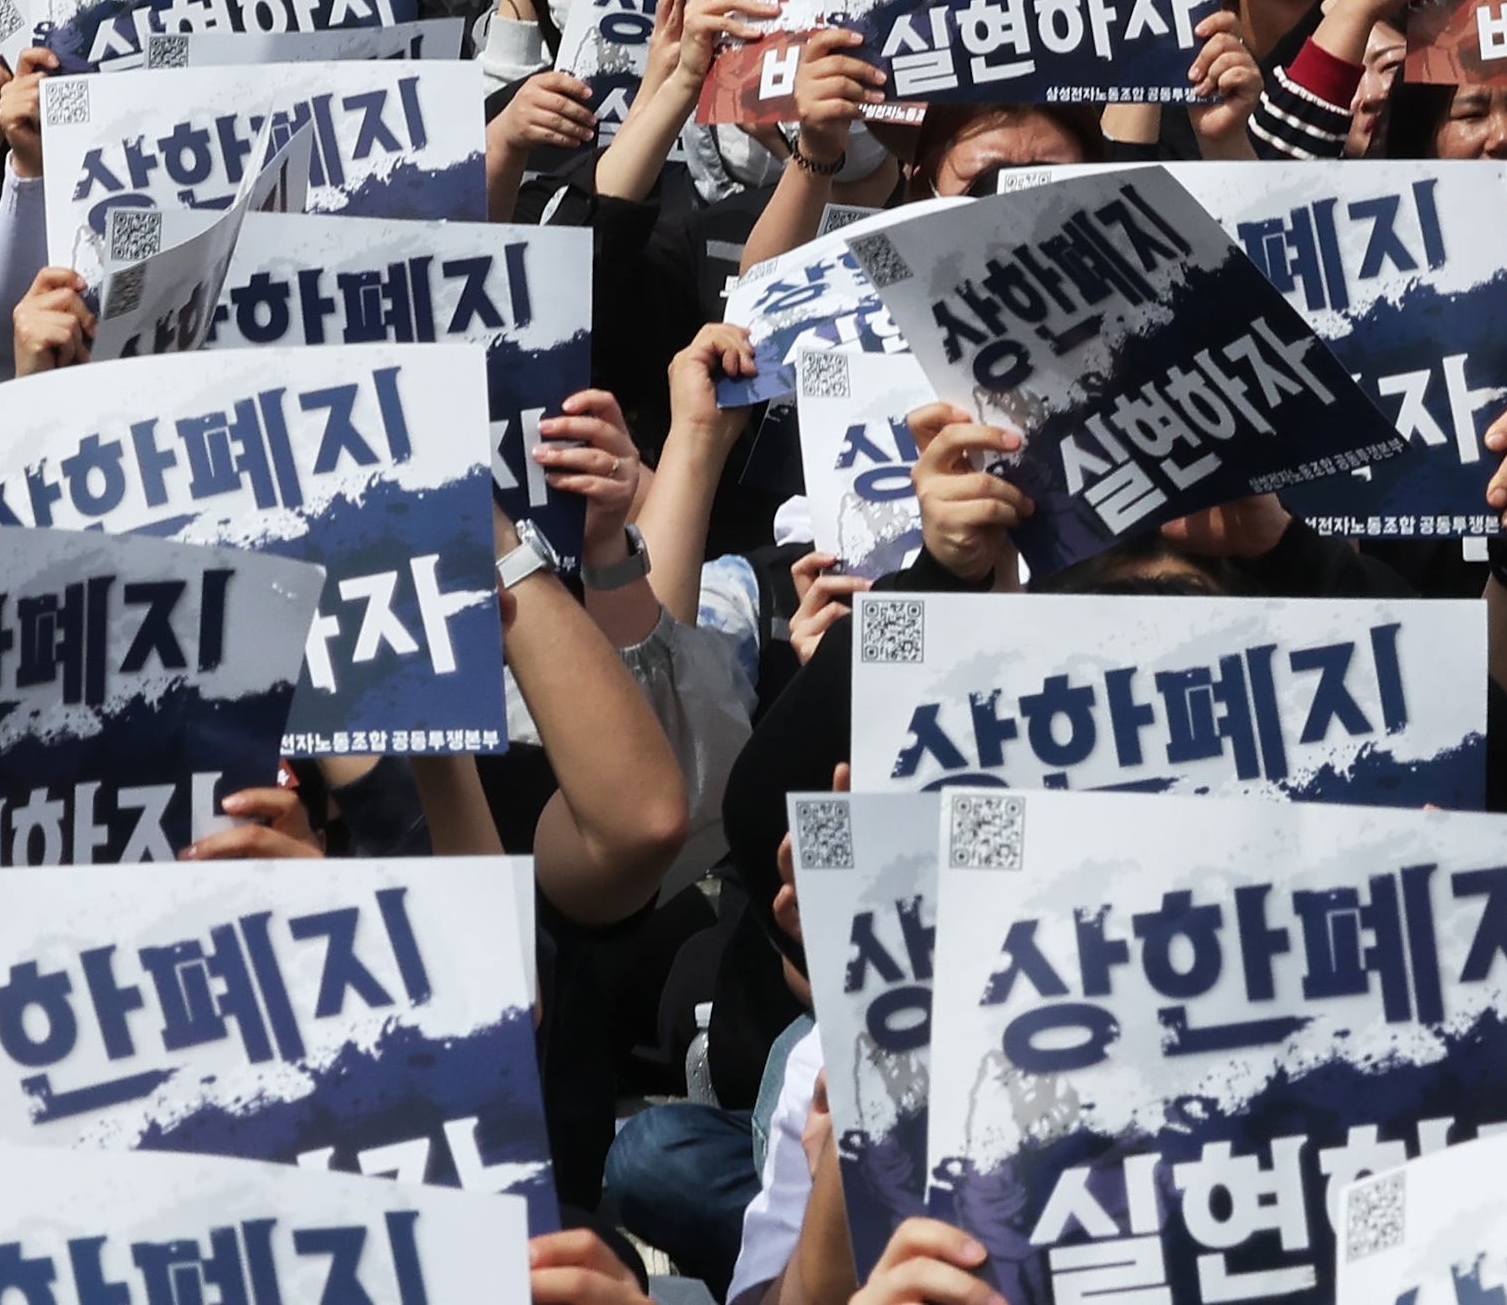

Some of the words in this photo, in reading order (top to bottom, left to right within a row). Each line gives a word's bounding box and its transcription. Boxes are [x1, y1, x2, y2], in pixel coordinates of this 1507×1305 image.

[206, 243, 531, 344] 한폐지
[933, 185, 1191, 392] 상한폐지
[1234, 178, 1448, 311] 폐지
[1059, 319, 1338, 537] 실현하자
[1420, 515, 1502, 535] 공동투쟁본
[280, 732, 386, 755] 전자노동조합
[390, 730, 500, 752] 공동투쟁본부
[891, 624, 1409, 792] 상한폐지
